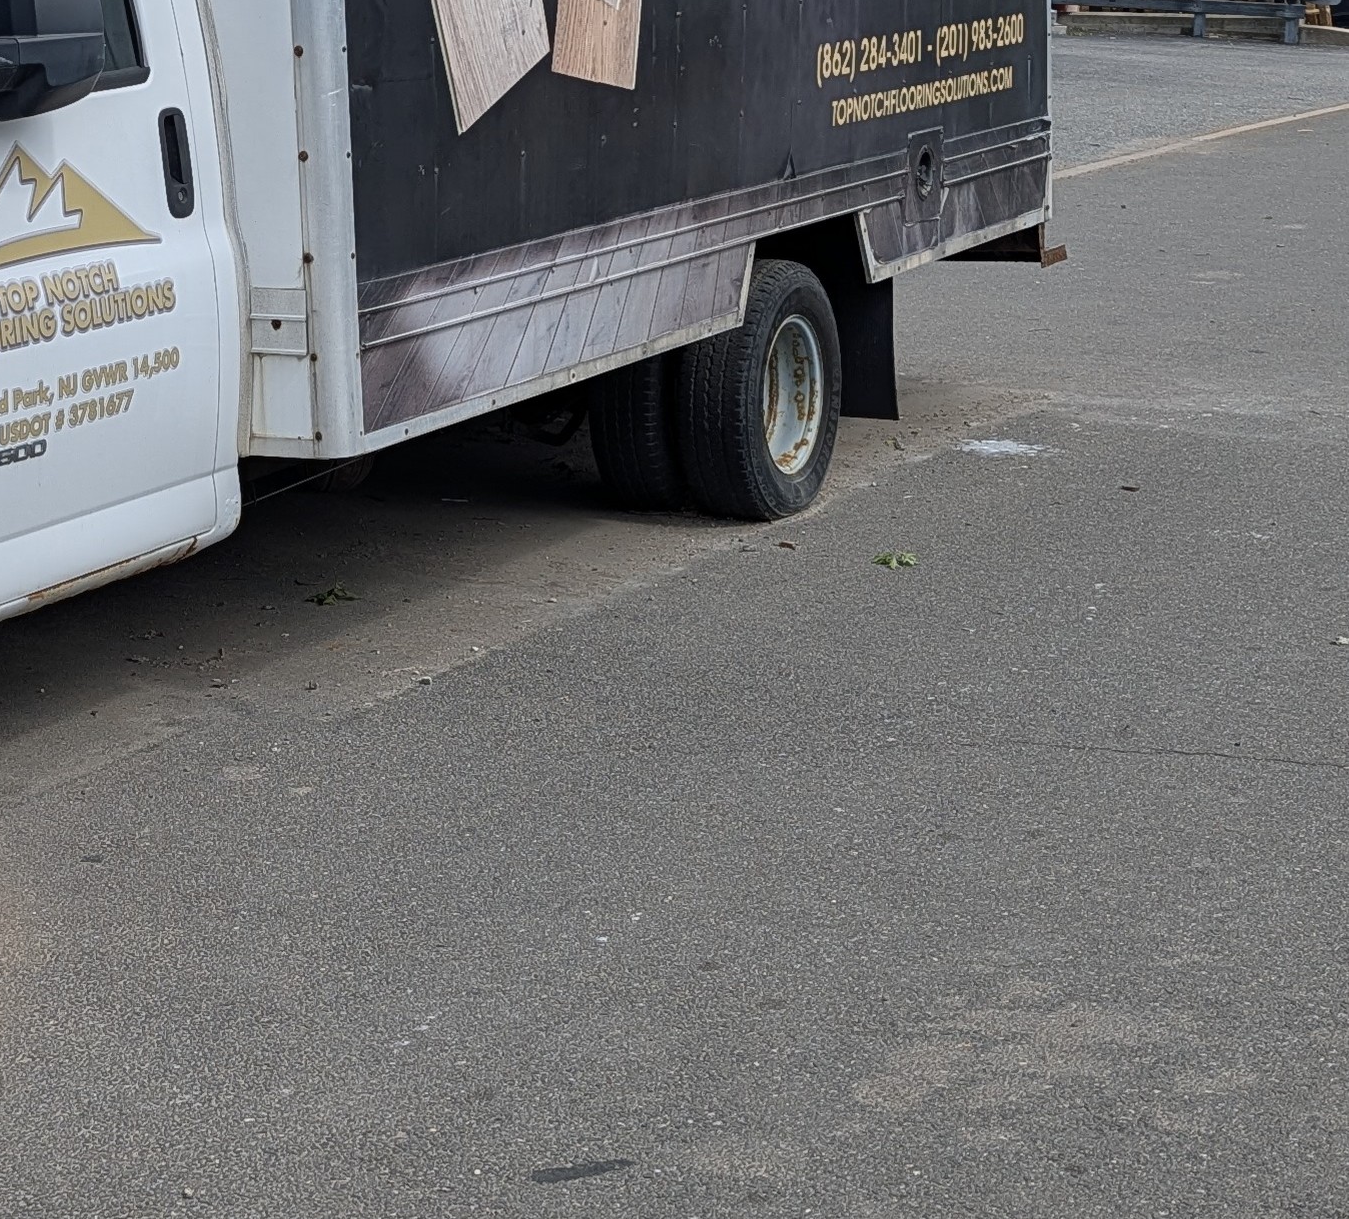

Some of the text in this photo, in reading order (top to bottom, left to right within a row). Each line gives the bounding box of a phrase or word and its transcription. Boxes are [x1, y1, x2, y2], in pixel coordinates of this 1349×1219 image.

[816, 39, 857, 89] (862)
[859, 30, 923, 73] 284-3401
[936, 22, 969, 68] (201)
[971, 12, 1024, 52] 983-2600
[831, 66, 1014, 127] TOPNOTCHFLOORINGSOLUTIONS.COM
[41, 260, 120, 307] NOTCH
[61, 277, 177, 336] SOLUTIONS
[12, 381, 55, 410] Park,
[57, 373, 78, 401] NJ
[80, 360, 129, 392] GVWR
[131, 346, 180, 380] 14,500
[54, 410, 66, 432] #
[67, 389, 135, 428] 3781677
